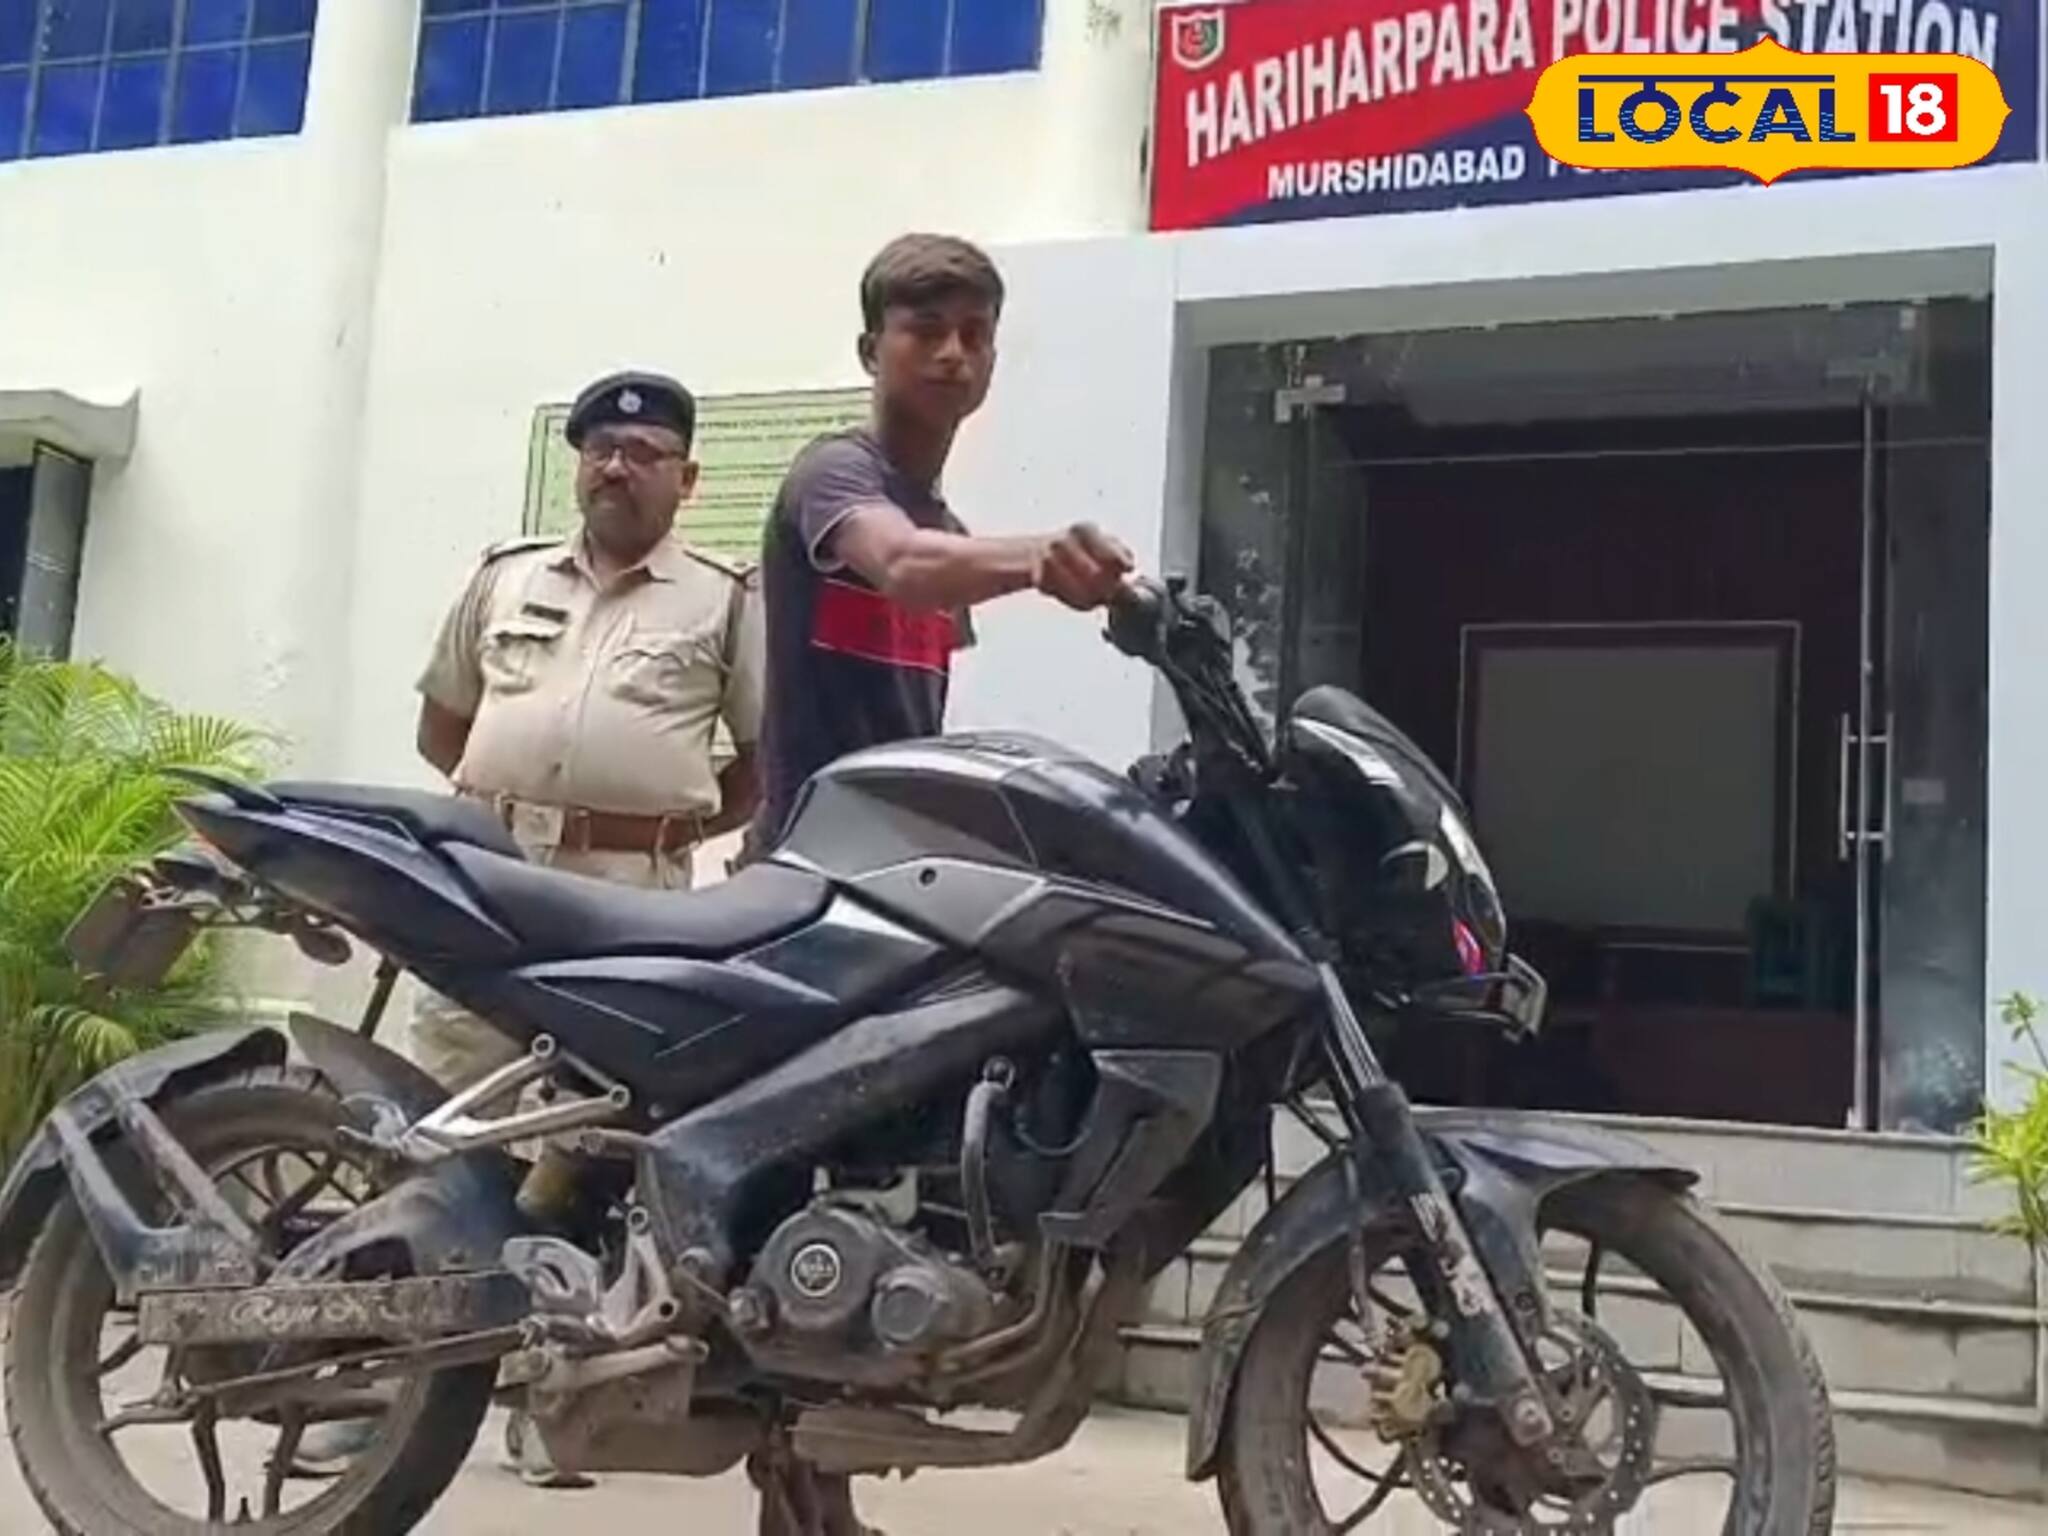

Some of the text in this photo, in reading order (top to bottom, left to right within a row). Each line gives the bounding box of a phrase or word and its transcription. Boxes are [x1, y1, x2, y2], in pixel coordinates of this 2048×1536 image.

[1186, 0, 1998, 168] HARIHARPARA POLICE STATION
[1267, 146, 1526, 199] MURSHIDABAD
